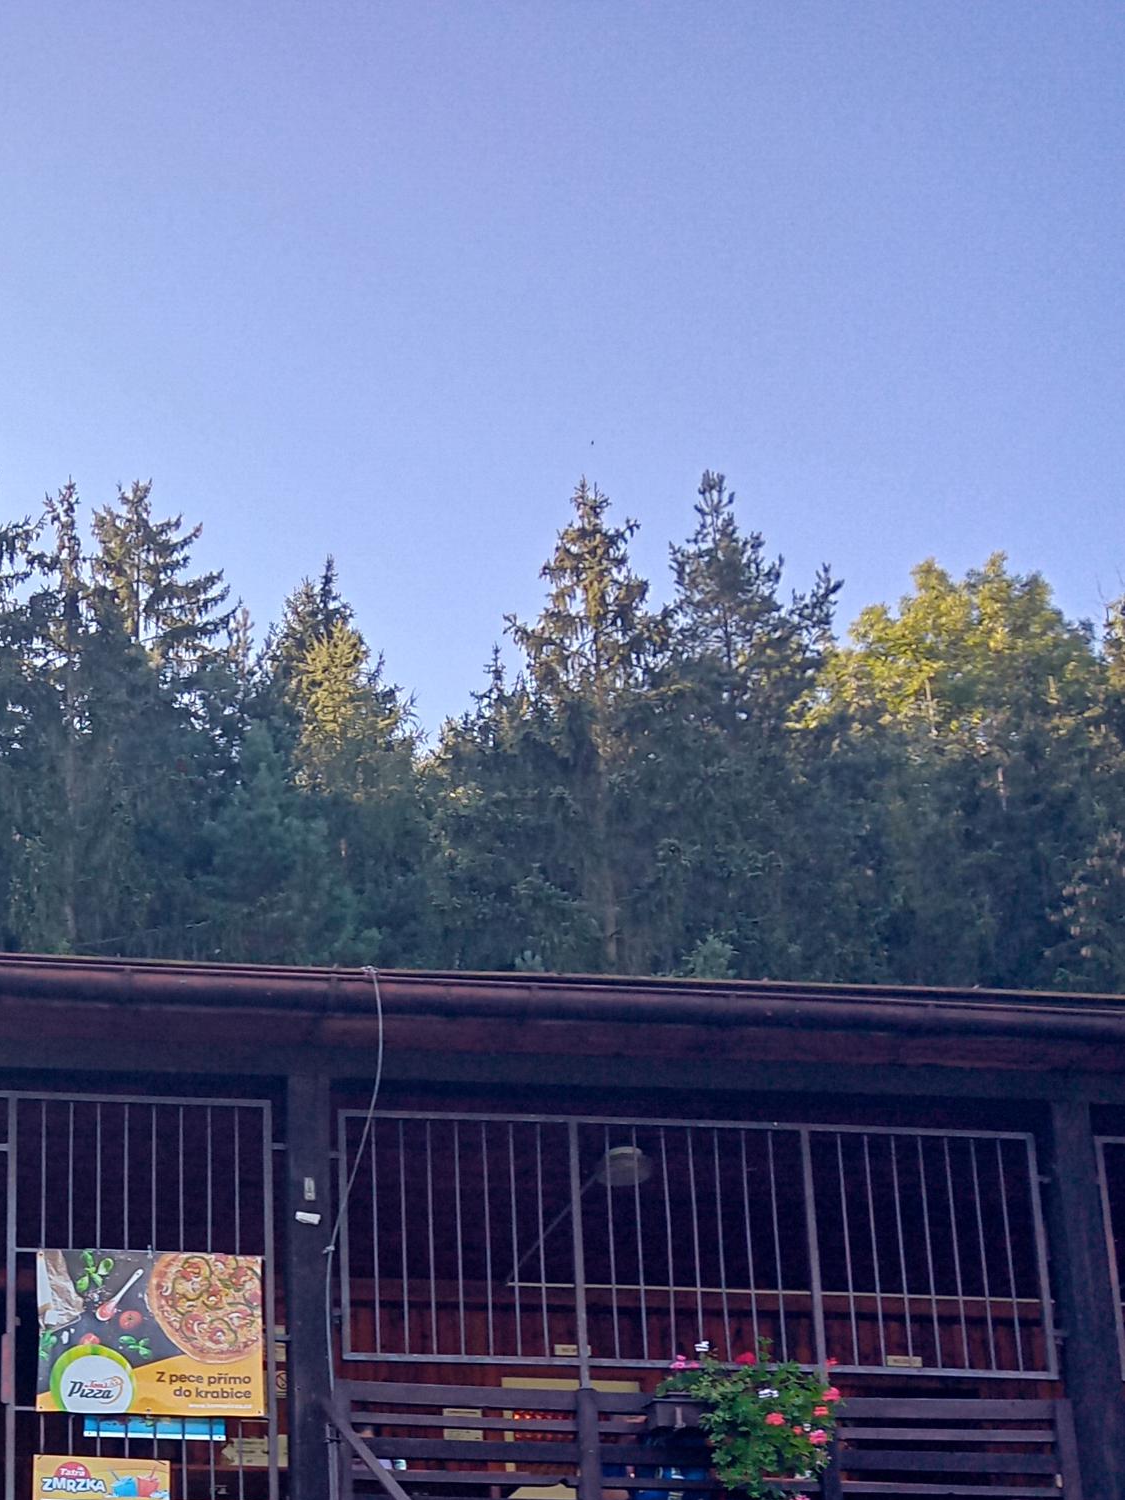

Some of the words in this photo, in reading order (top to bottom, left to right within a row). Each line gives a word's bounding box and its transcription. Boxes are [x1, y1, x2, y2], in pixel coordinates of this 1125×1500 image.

[155, 1371, 166, 1383] Z
[169, 1374, 204, 1386] pece
[207, 1372, 252, 1387] přímo
[67, 1380, 114, 1399] Pizza
[173, 1386, 191, 1398] do
[195, 1386, 252, 1399] krabice
[59, 1467, 86, 1477] Tatra
[42, 1476, 107, 1493] ZMRZKA
